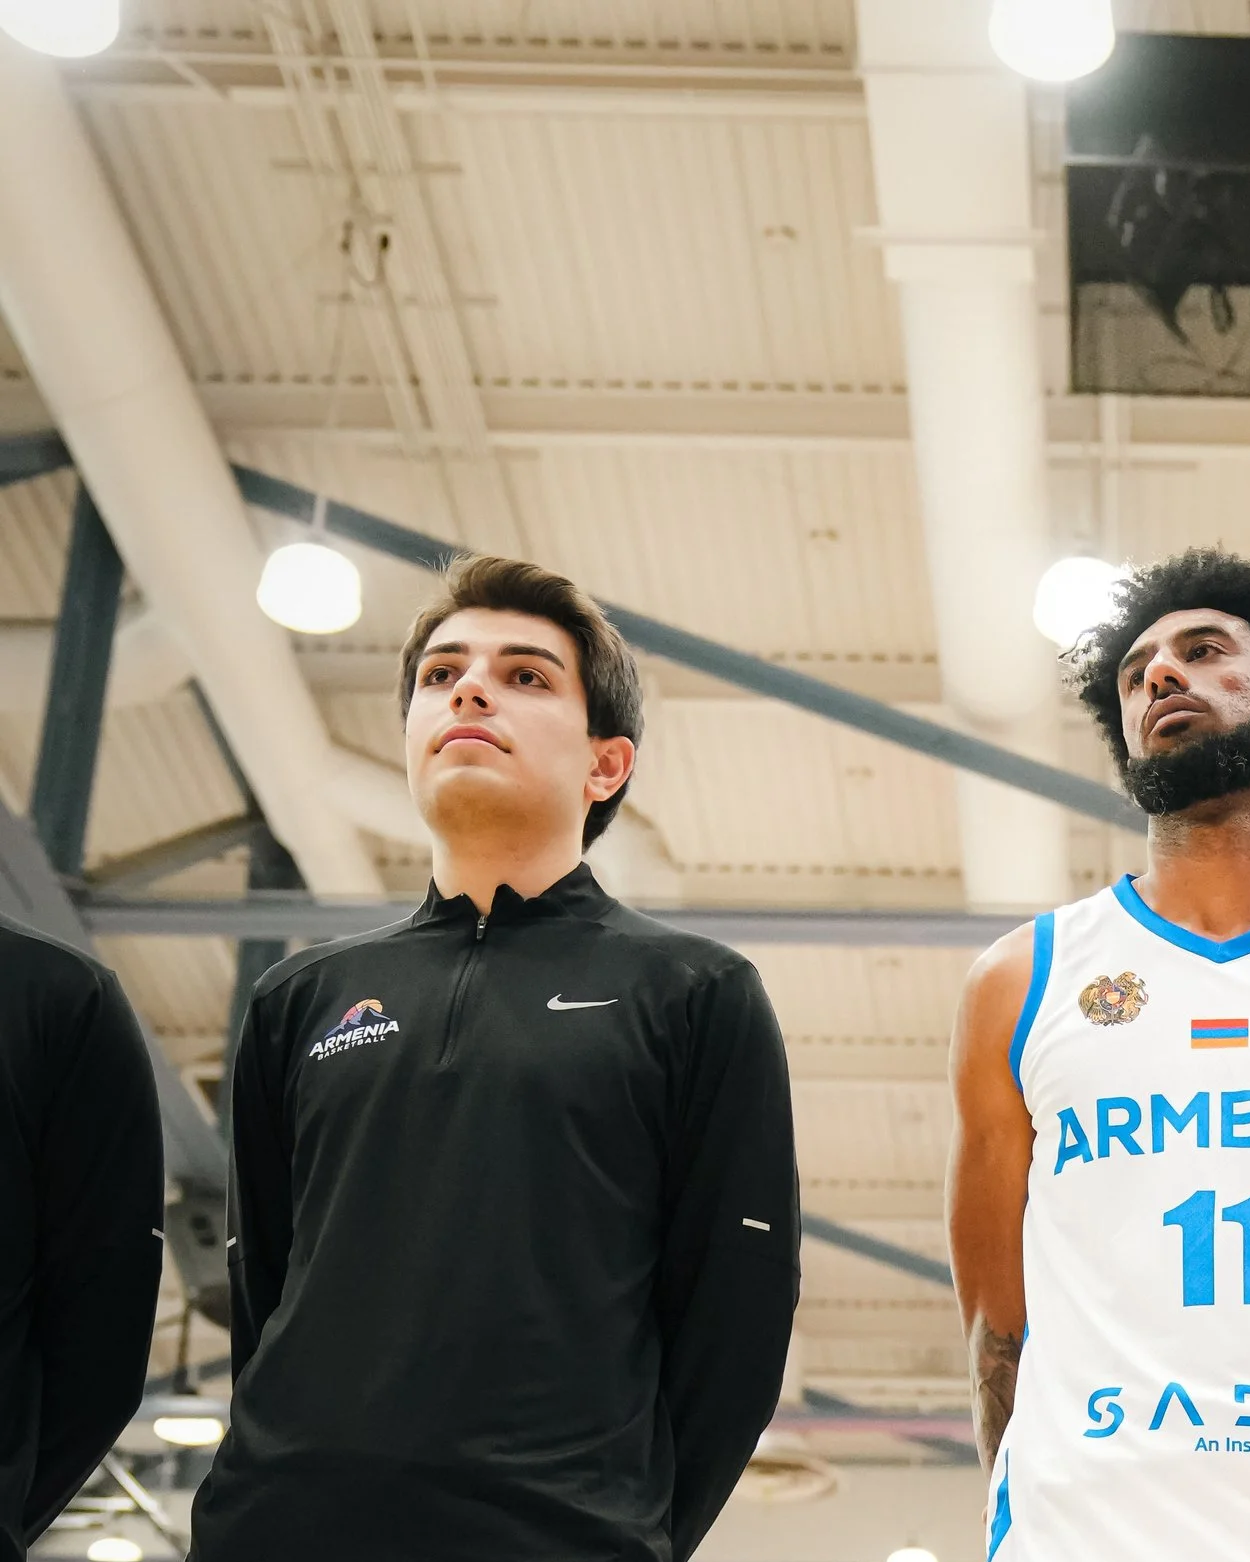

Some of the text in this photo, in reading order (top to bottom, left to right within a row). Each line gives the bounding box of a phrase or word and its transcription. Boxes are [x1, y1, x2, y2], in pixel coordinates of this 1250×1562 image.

[309, 1020, 400, 1057] ARMENIA
[317, 1035, 386, 1061] BASKETBALL
[1195, 1437, 1220, 1452] An
